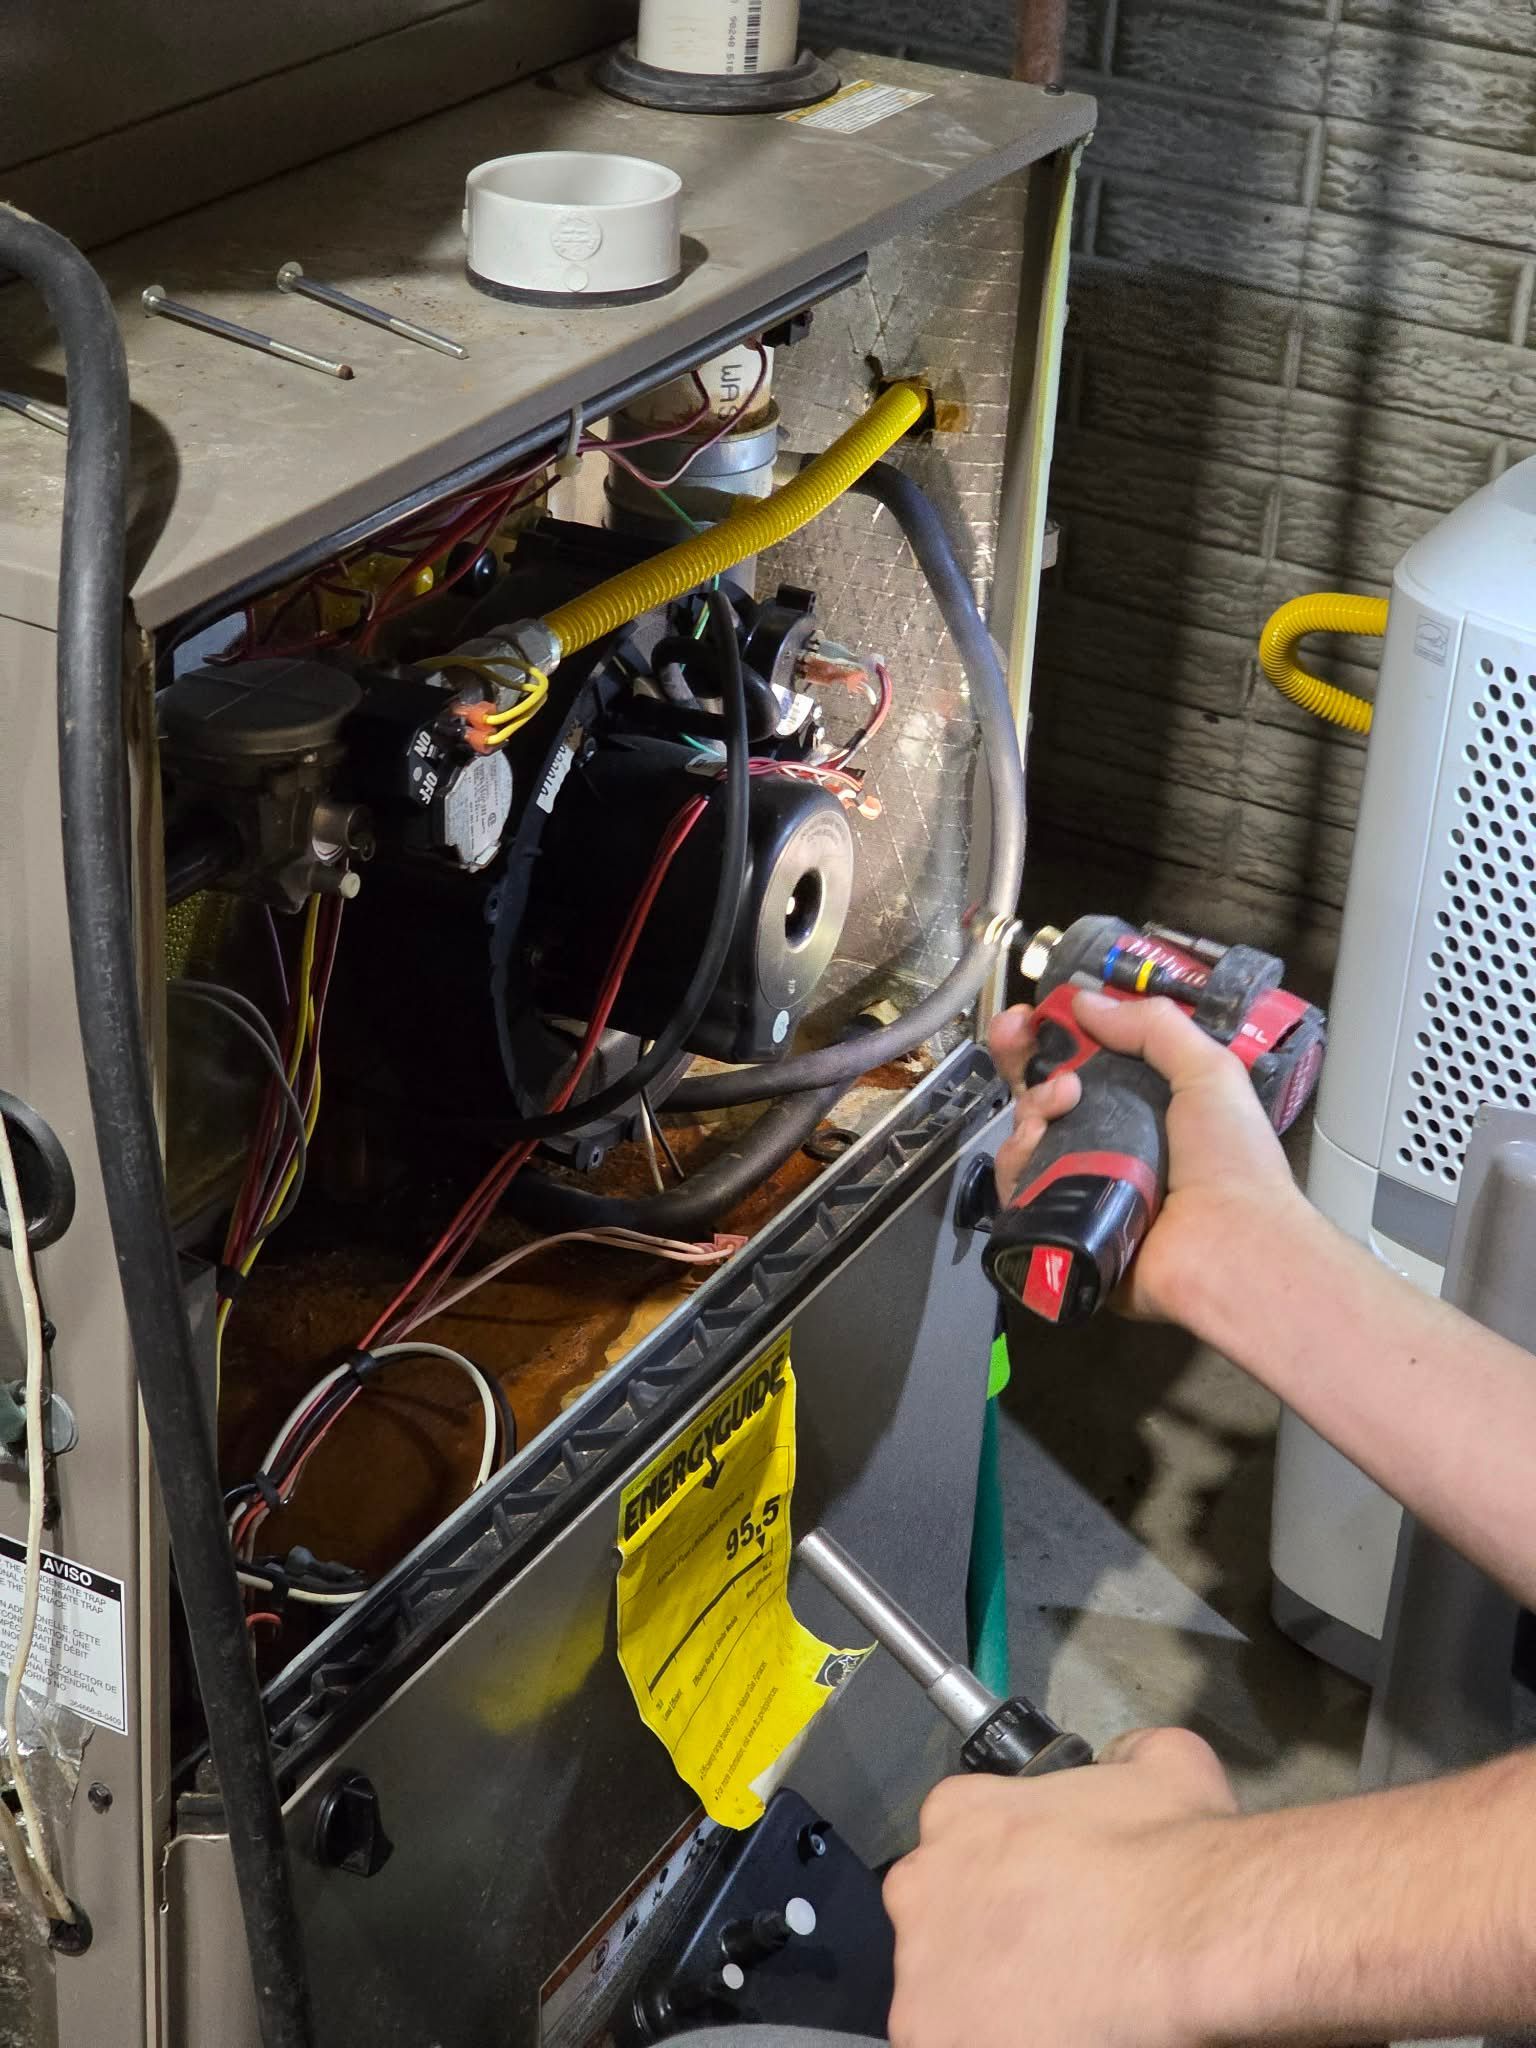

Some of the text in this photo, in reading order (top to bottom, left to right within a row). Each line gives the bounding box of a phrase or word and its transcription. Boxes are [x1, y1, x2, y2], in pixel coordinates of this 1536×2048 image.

[719, 364, 742, 420] WAS
[413, 730, 432, 758] ON
[418, 770, 438, 805] OFF
[623, 1351, 787, 1542] ENERGYGUIDE
[726, 1494, 781, 1561] 95.5
[43, 1557, 93, 1587] AVISO
[80, 1600, 104, 1615] TRAP
[84, 1591, 107, 1606] TRAP
[63, 1643, 89, 1659] DÉBIT
[72, 1629, 102, 1647] CETTE
[72, 1638, 91, 1652] UNE
[56, 1663, 103, 1688] COLECTOR
[105, 1683, 118, 1694] DE
